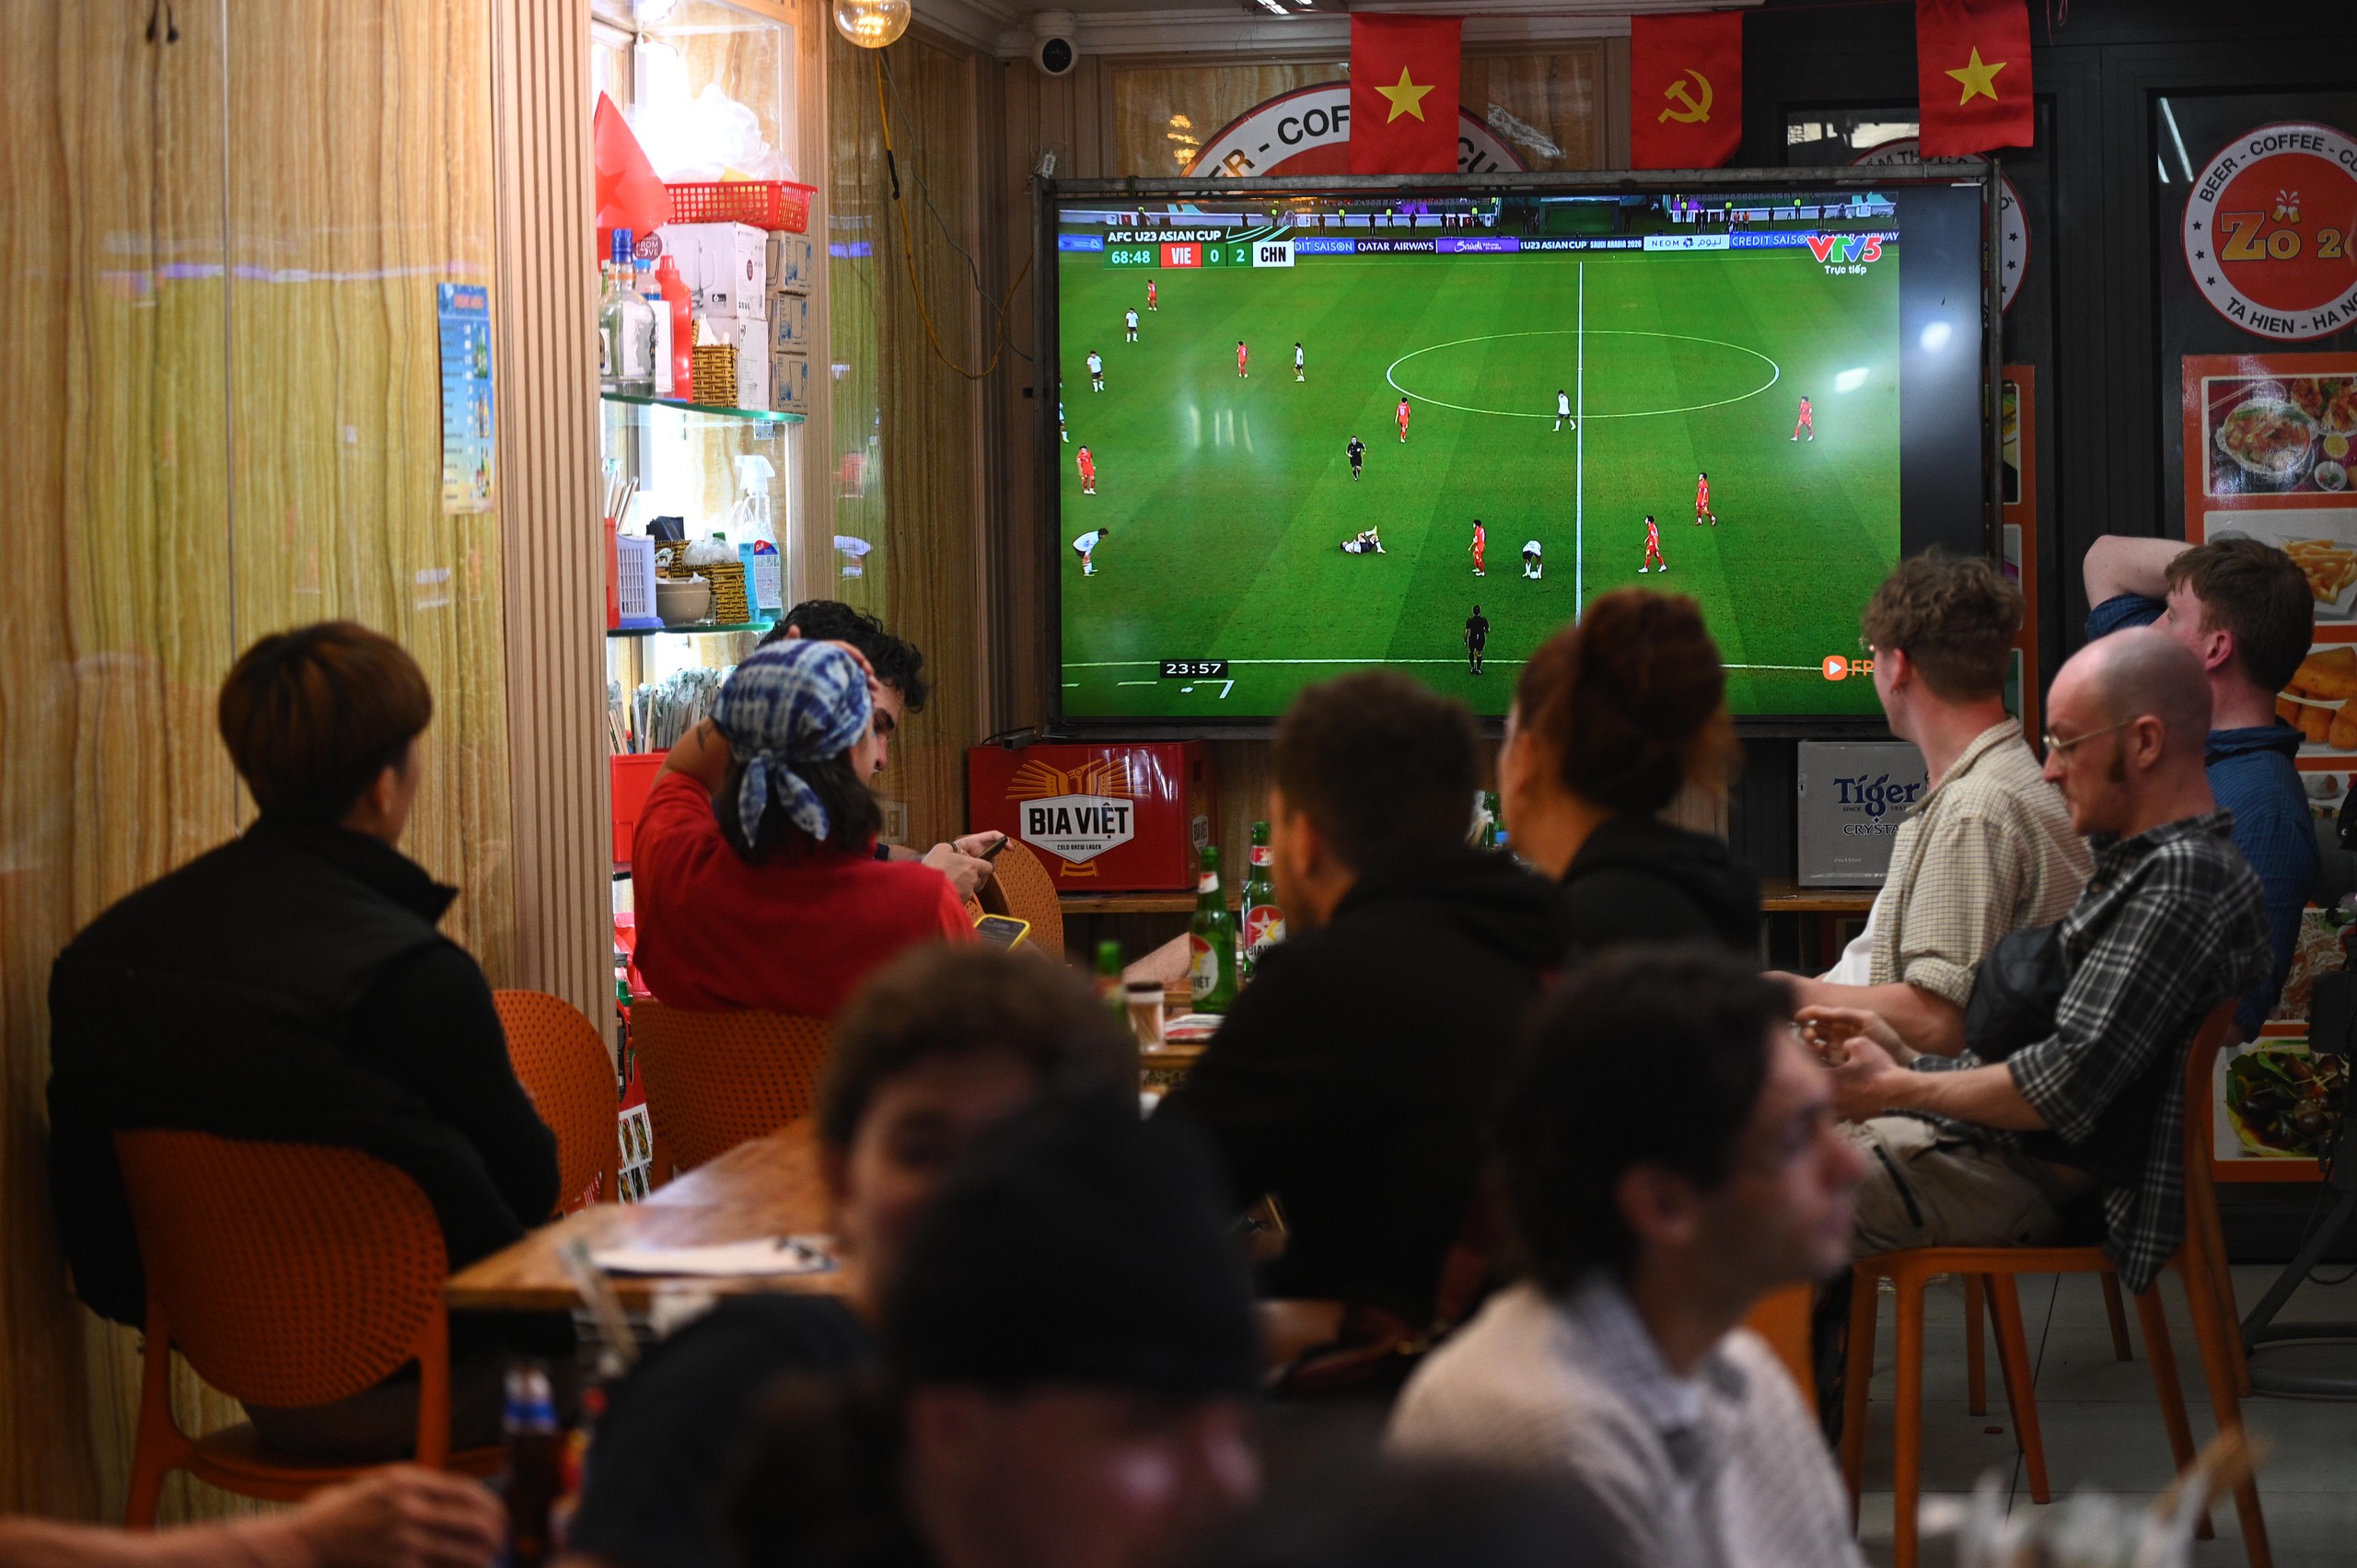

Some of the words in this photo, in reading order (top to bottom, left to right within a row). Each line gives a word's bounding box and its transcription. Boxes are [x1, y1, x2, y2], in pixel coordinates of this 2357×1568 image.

[1277, 104, 1351, 145] COF
[2199, 157, 2238, 203] BEER
[2249, 134, 2326, 157] COFFEE
[1108, 231, 1132, 242] AFC
[1134, 231, 1157, 242] U23
[1158, 231, 1195, 241] ASIAN
[1196, 230, 1222, 241] CUP
[1732, 236, 1770, 247] CREDIT
[636, 240, 658, 249] FROM
[1295, 241, 1312, 251] DIT
[1314, 241, 1353, 251] SAISON
[1357, 242, 1390, 252] QATAR
[1393, 241, 1434, 251] AIRWAYS
[1524, 241, 1540, 250] U23
[1541, 240, 1568, 250] ASIAN
[1569, 240, 1587, 250] CUP
[1652, 239, 1679, 248] NEOM
[1806, 236, 1883, 263] VTV5
[1111, 250, 1151, 264] 68:48
[1171, 247, 1192, 265] VIE
[1210, 249, 1220, 263] 0
[1236, 249, 1246, 262] 2
[1260, 246, 1286, 262] CHN
[1824, 265, 1846, 275] Trực
[1849, 263, 1867, 275] tiếp
[2226, 296, 2246, 320] TA
[2249, 311, 2294, 334] HIEN
[2312, 310, 2341, 331] HA
[1166, 663, 1222, 674] 23:57
[1852, 659, 1875, 677] FP
[1833, 773, 1922, 817] Tiger
[1028, 807, 1073, 835] BIA
[1074, 801, 1129, 839] VIỆT
[1843, 823, 1899, 836] CRYSTA
